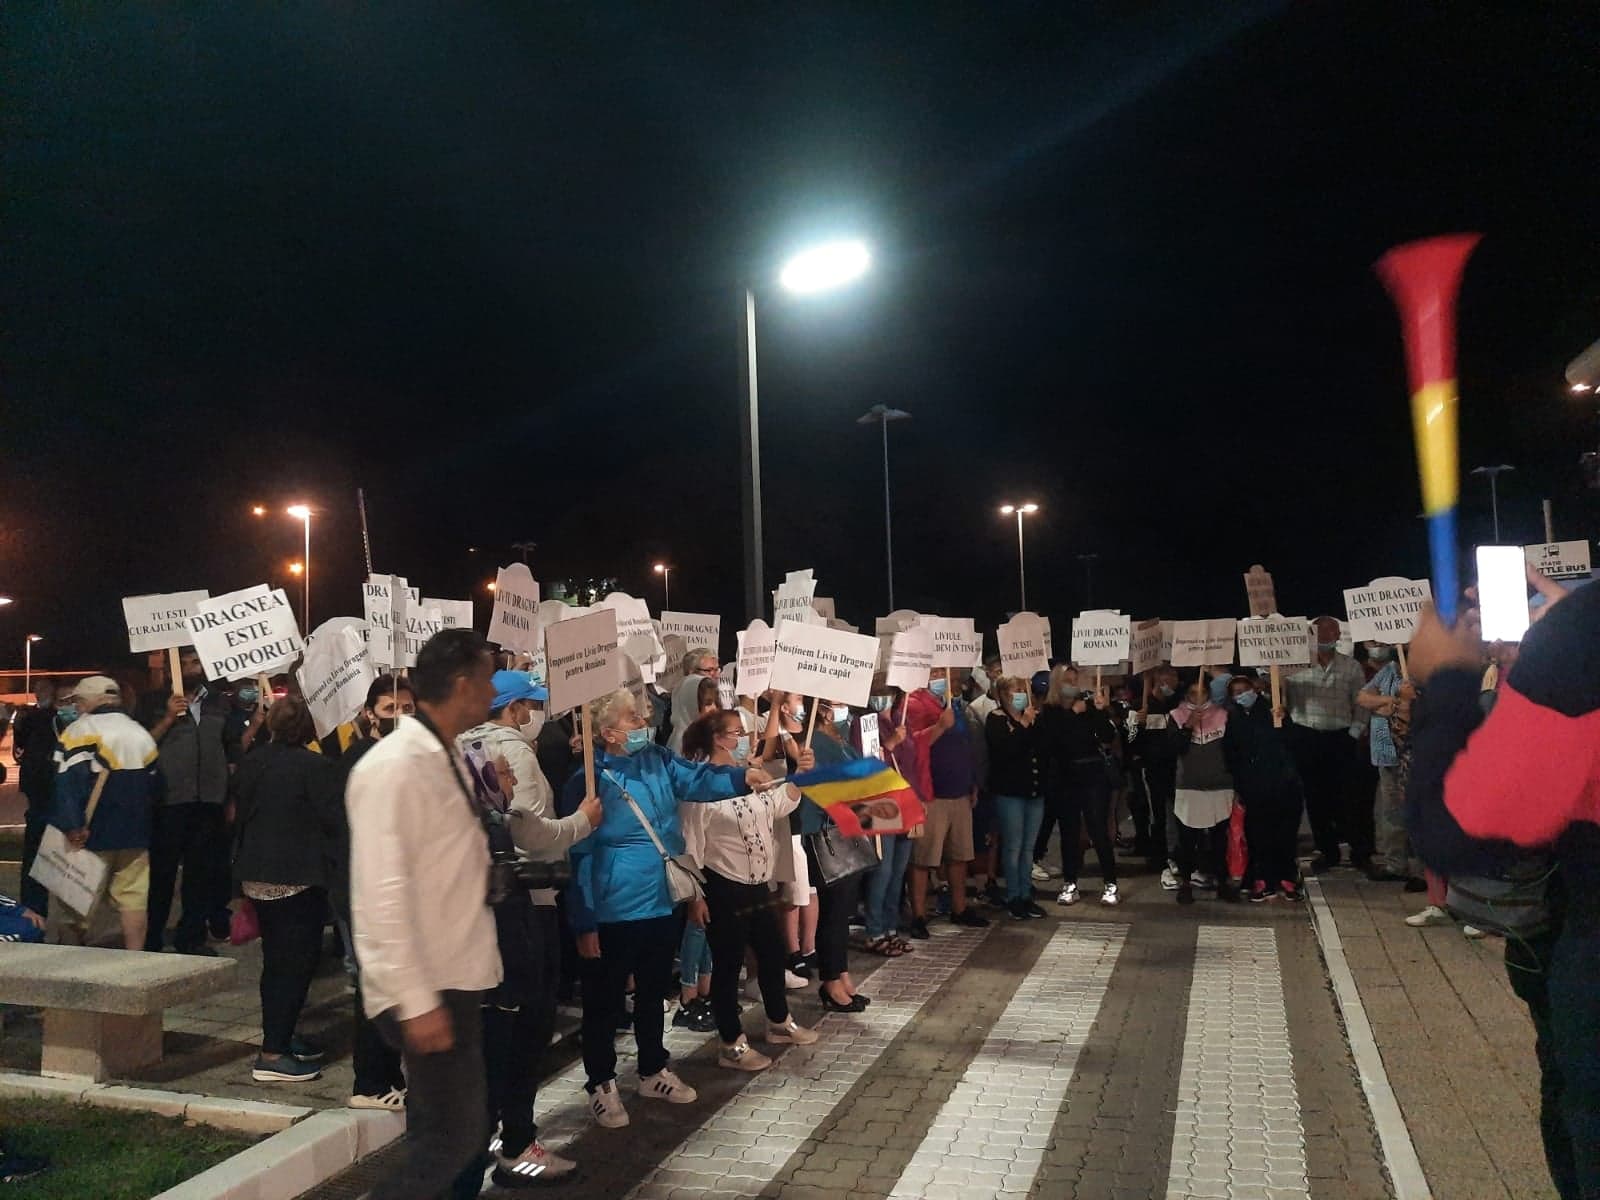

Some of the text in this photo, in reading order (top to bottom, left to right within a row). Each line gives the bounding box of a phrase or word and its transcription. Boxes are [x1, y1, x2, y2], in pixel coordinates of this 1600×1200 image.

[1566, 564, 1586, 572] BUS
[1353, 587, 1424, 605] LIVIU DRAGNEA
[152, 611, 163, 620] TU
[190, 594, 285, 633] DRAGNEA
[1349, 606, 1383, 620] PENTRU
[1385, 603, 1399, 616] UN
[129, 623, 171, 636] CURAJUL
[1375, 618, 1414, 632] MAI BUN
[225, 620, 272, 647] ESTE
[1073, 626, 1129, 639] LIVIU DRAGNEA
[1083, 639, 1118, 649] ROMANIA
[212, 637, 302, 677] POPORUL
[816, 650, 838, 662] Liviu
[839, 654, 873, 670] Dragnea
[819, 664, 827, 674] la
